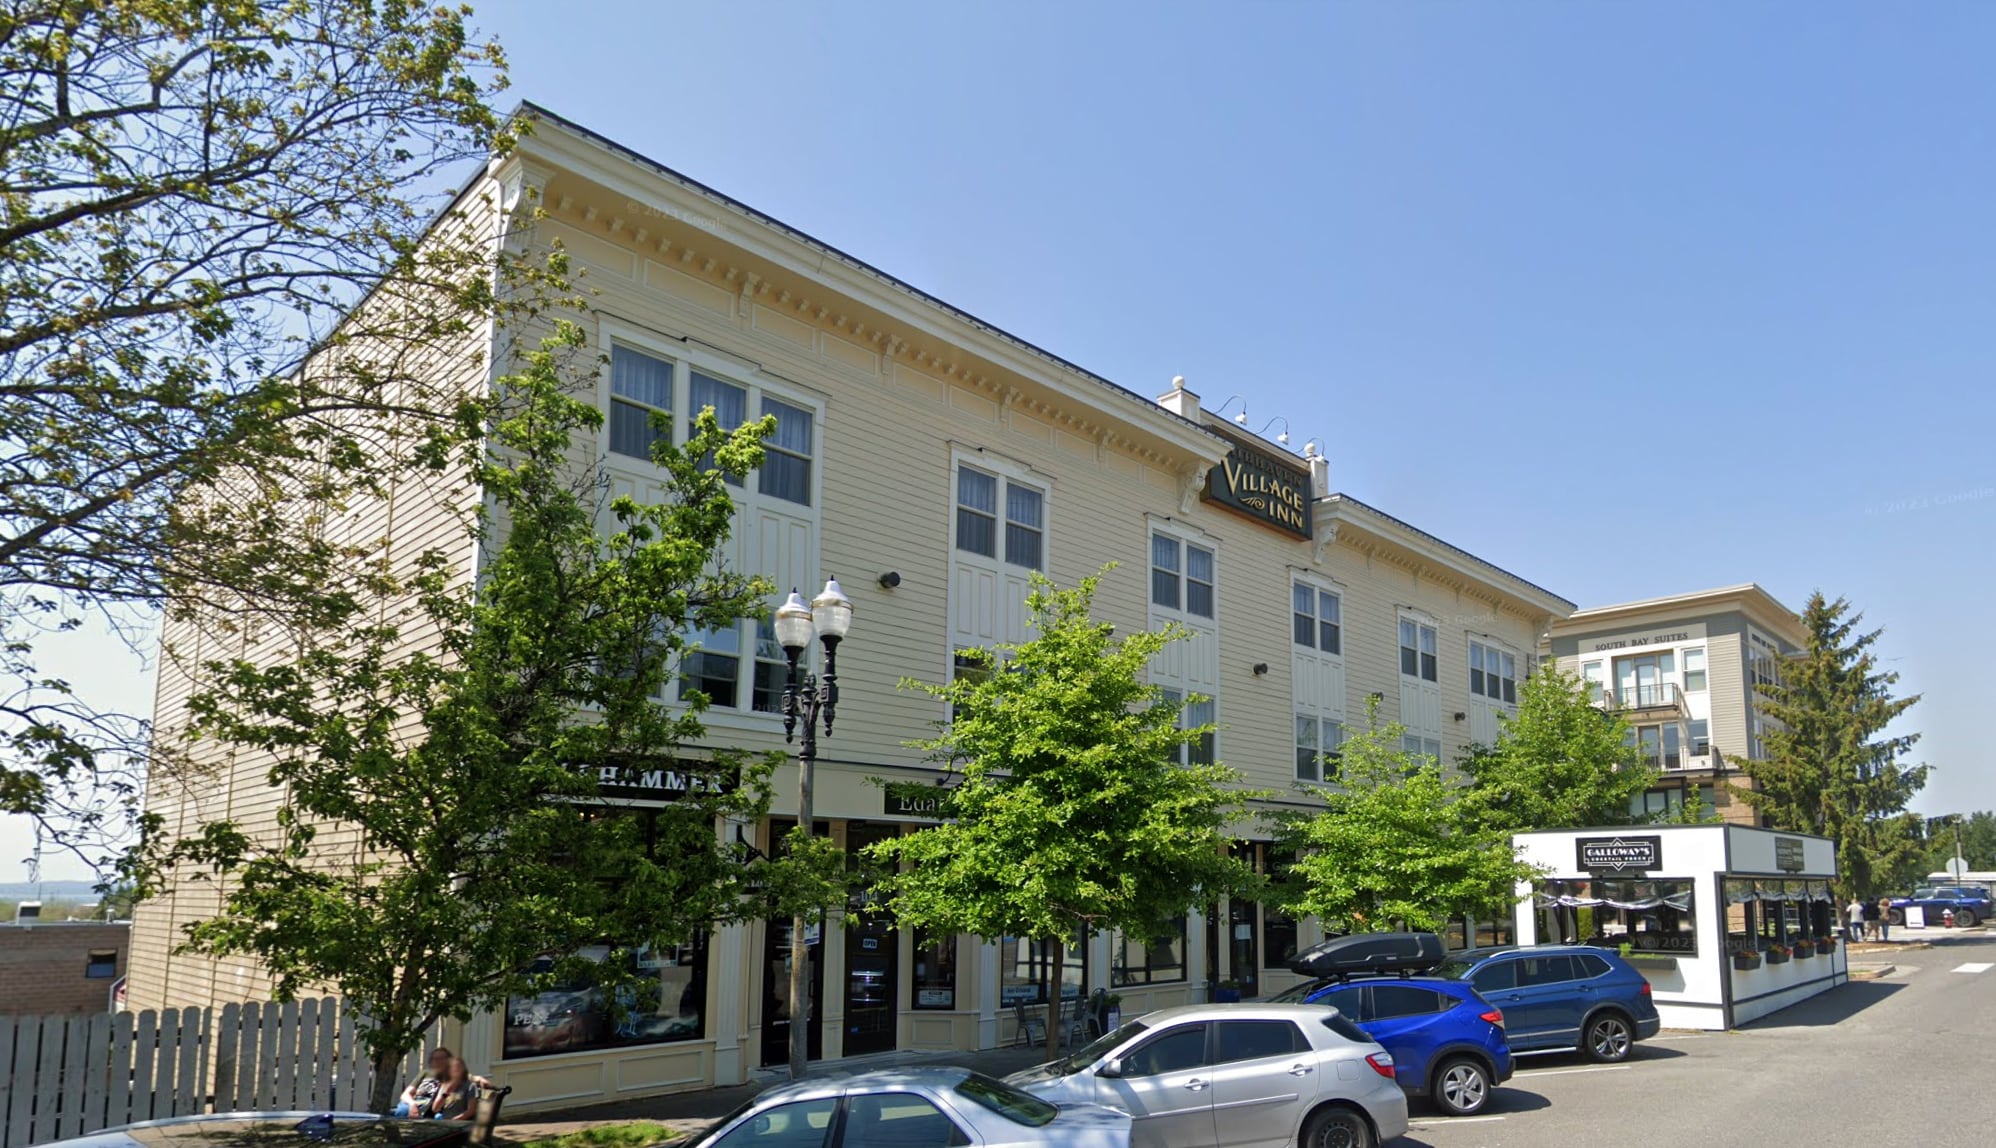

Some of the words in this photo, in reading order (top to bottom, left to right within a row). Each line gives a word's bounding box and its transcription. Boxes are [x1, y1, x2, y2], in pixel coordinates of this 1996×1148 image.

[1229, 446, 1302, 487] IRHAVEN
[1221, 456, 1303, 511] VILLAGE
[1269, 501, 1303, 529] INN
[1595, 640, 1626, 651] SOUTH
[1631, 637, 1649, 646] BAY
[1654, 632, 1688, 644] SUITES
[561, 762, 723, 793] HAMMER
[1587, 847, 1650, 857] GALLOWAY'S
